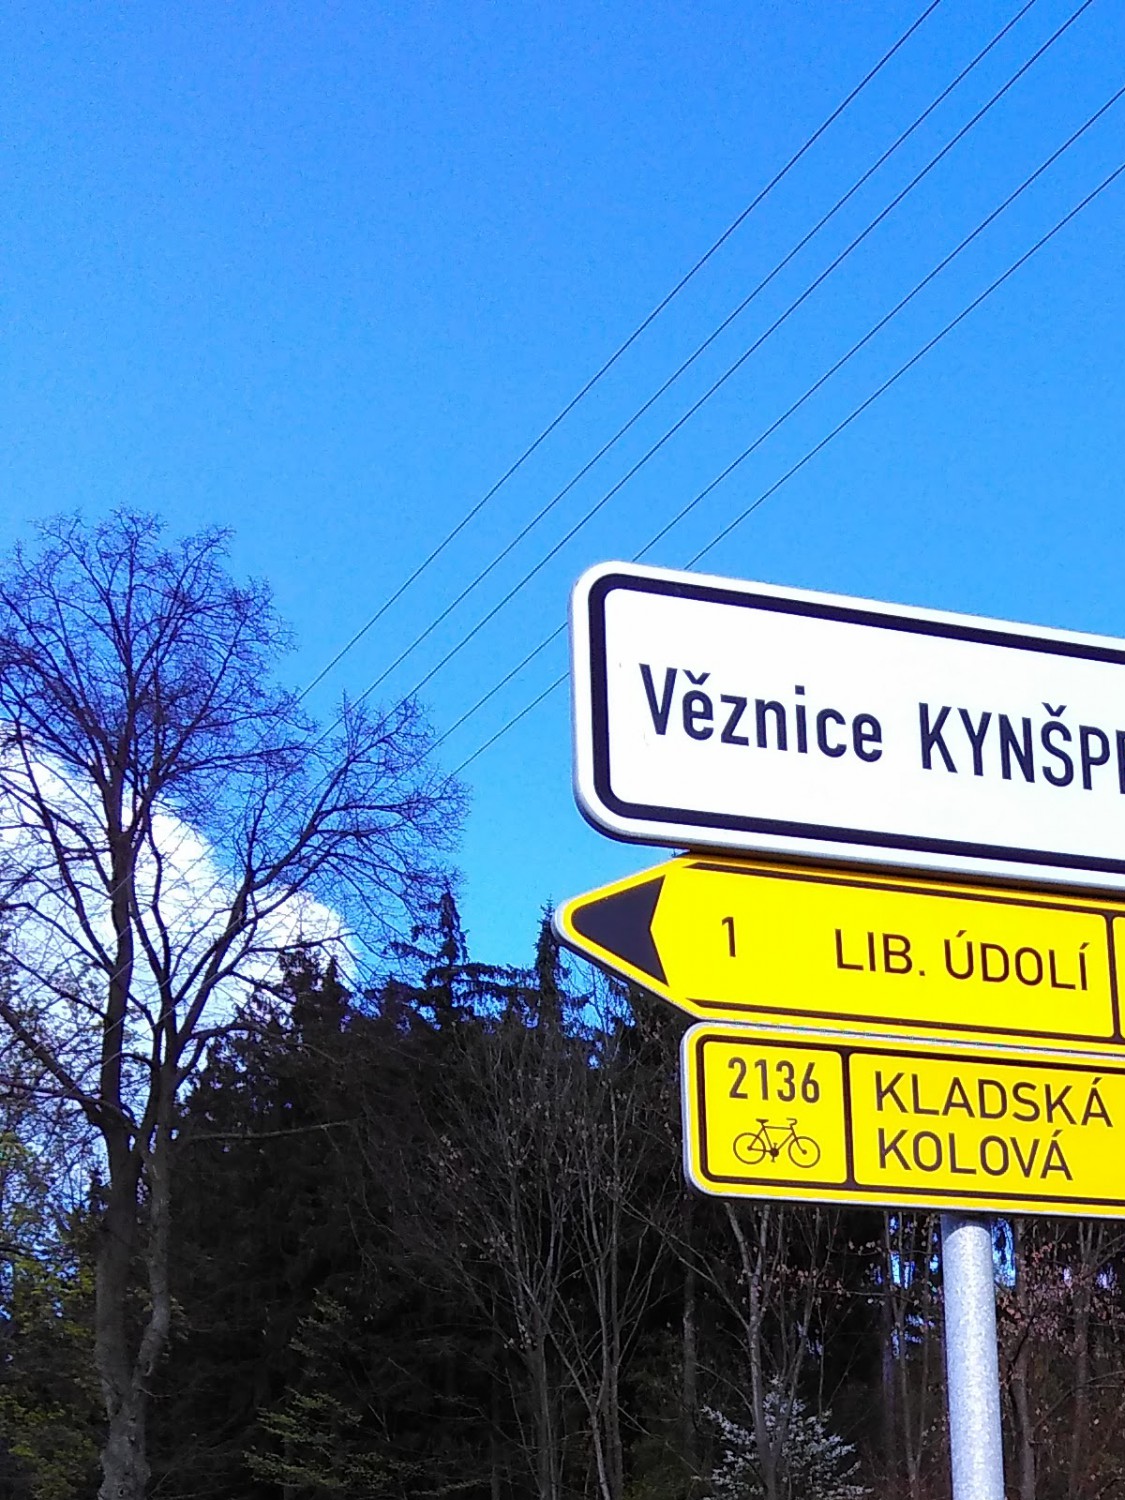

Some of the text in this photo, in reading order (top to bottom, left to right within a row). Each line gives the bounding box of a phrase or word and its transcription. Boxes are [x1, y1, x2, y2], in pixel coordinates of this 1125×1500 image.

[638, 662, 883, 763] Věznice
[721, 916, 1090, 991] 1 LIB. ÚDOLÍ
[728, 1057, 820, 1104] 2136
[874, 1071, 1113, 1128] KLADSKÁ
[877, 1128, 1073, 1181] KOLOVÁ
